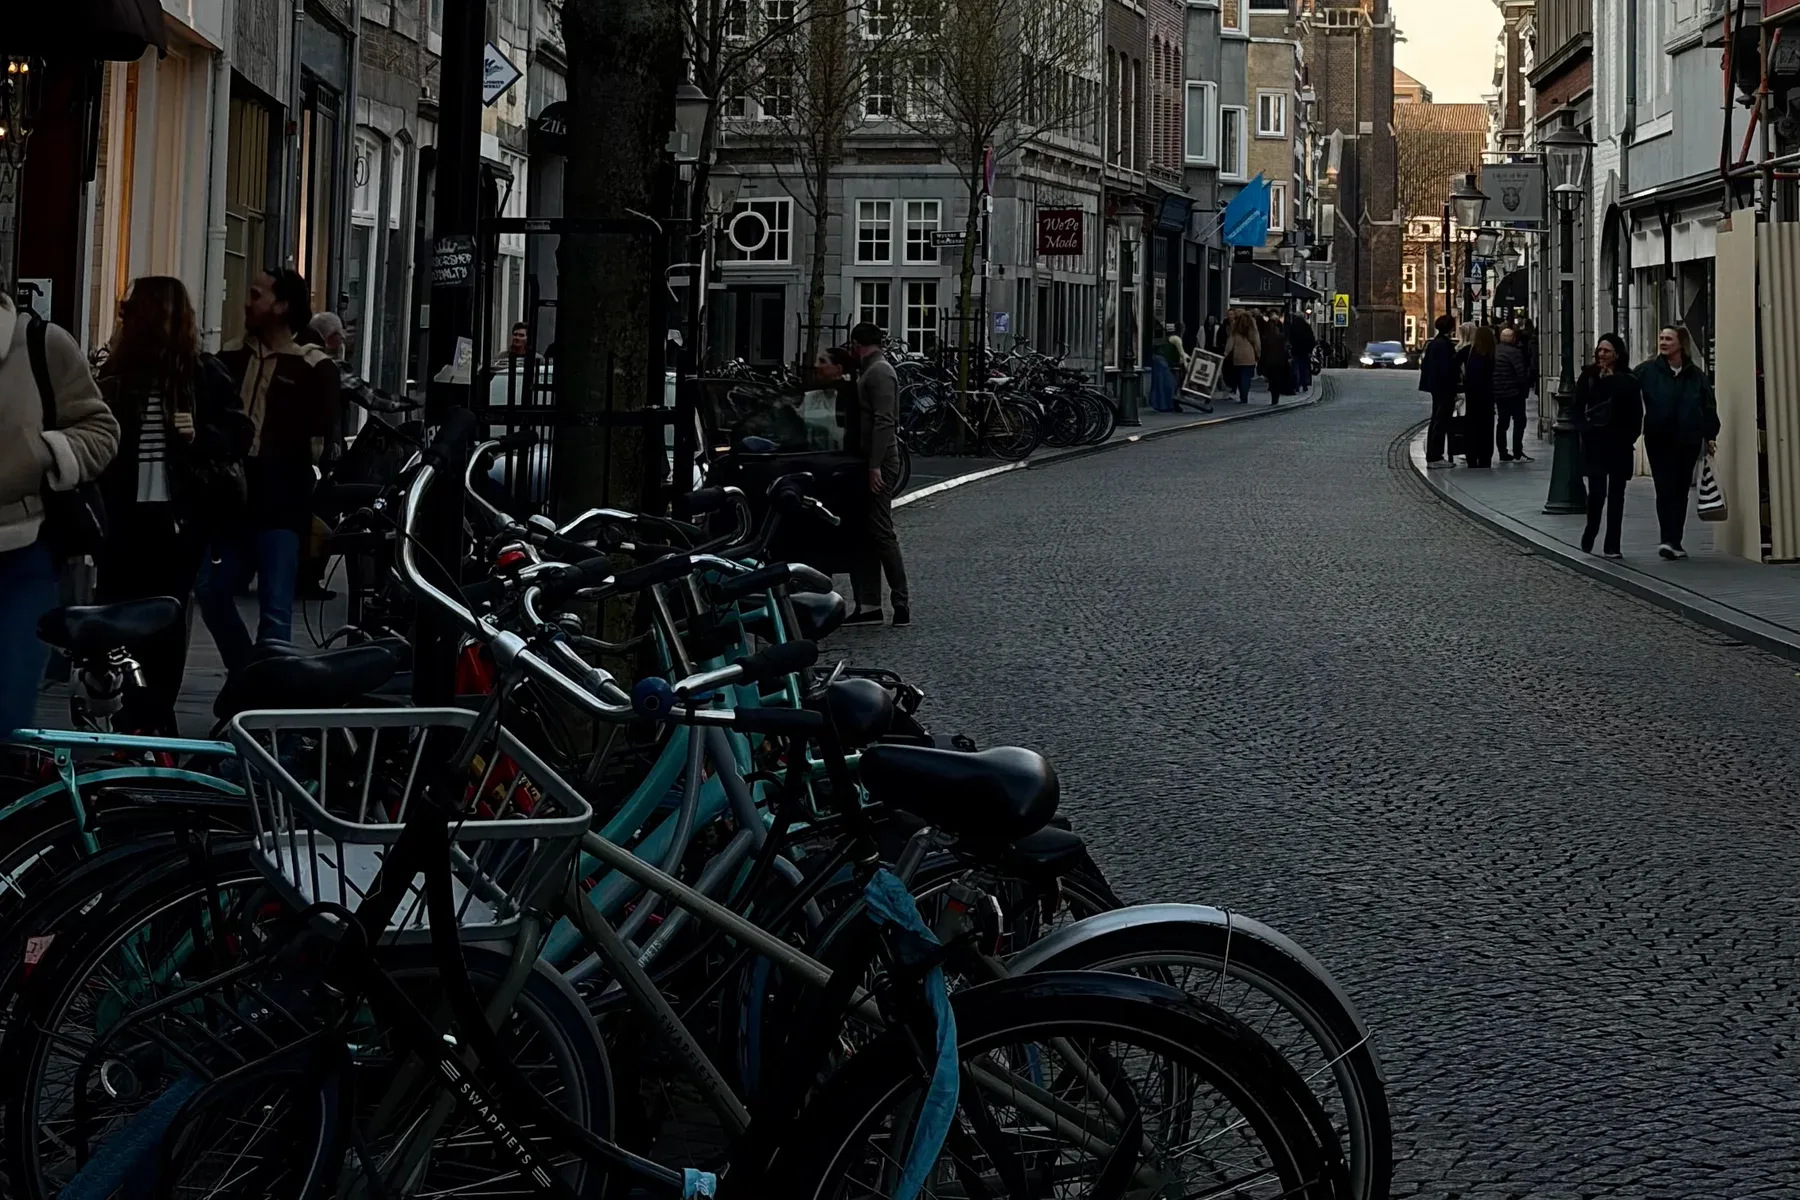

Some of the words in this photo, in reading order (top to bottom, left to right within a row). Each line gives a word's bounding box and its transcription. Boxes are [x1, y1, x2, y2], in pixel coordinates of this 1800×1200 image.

[1043, 217, 1079, 231] WePe
[1045, 232, 1078, 248] Mode
[660, 1013, 718, 1091] SWAPFIETS
[460, 1082, 532, 1165] SWAPFIETS
